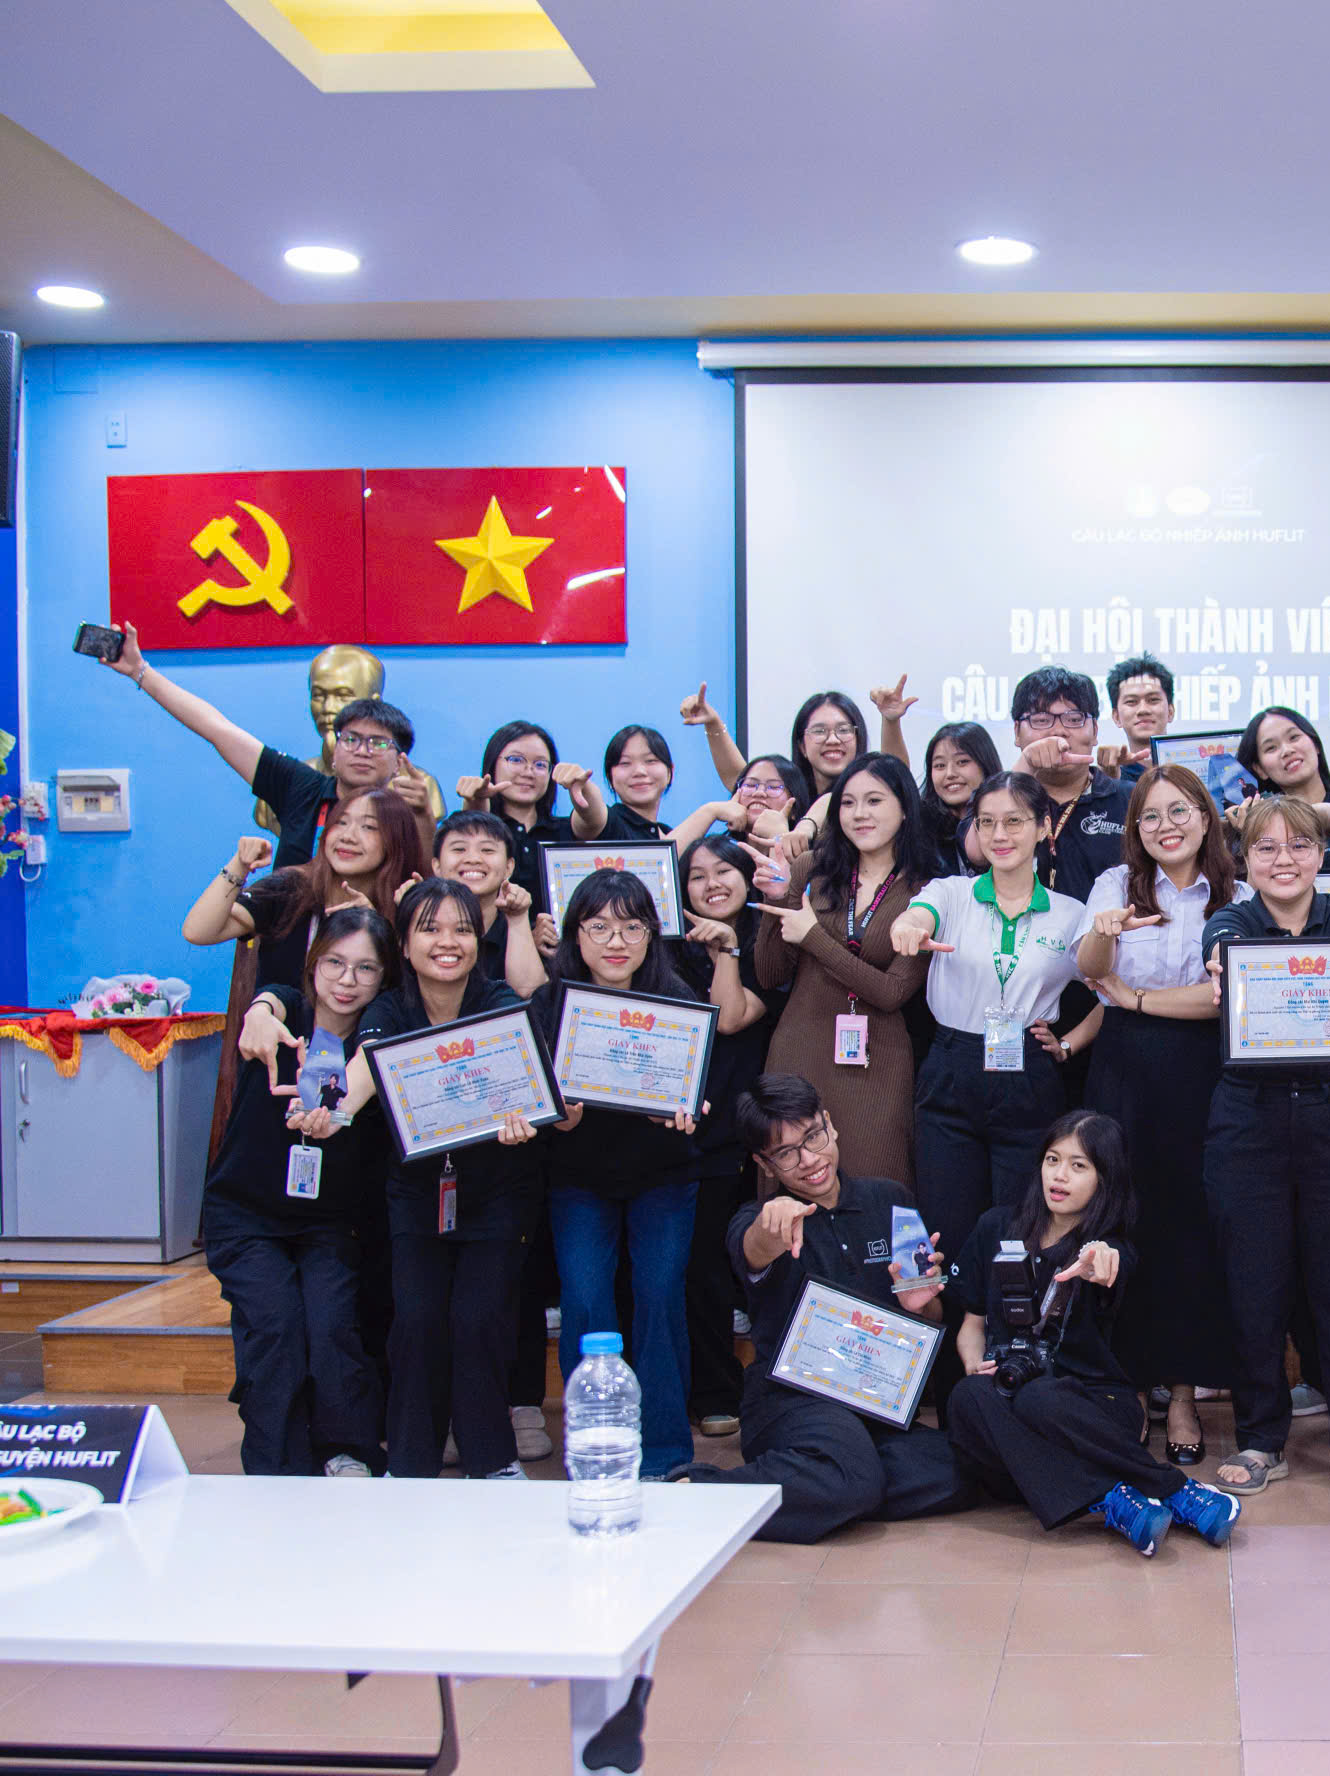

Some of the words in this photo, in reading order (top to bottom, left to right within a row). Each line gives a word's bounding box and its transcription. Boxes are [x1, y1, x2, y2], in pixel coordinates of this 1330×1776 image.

[1009, 607, 1070, 663] ĐẠI
[1083, 595, 1143, 661] HỘI
[1154, 597, 1273, 653] THÀNH
[942, 663, 1008, 722] CÂU
[1250, 659, 1319, 721] ẢNH
[17, 1424, 58, 1445] LẠC
[56, 1420, 87, 1445] BỘ
[52, 1450, 121, 1468] HUFLIT
